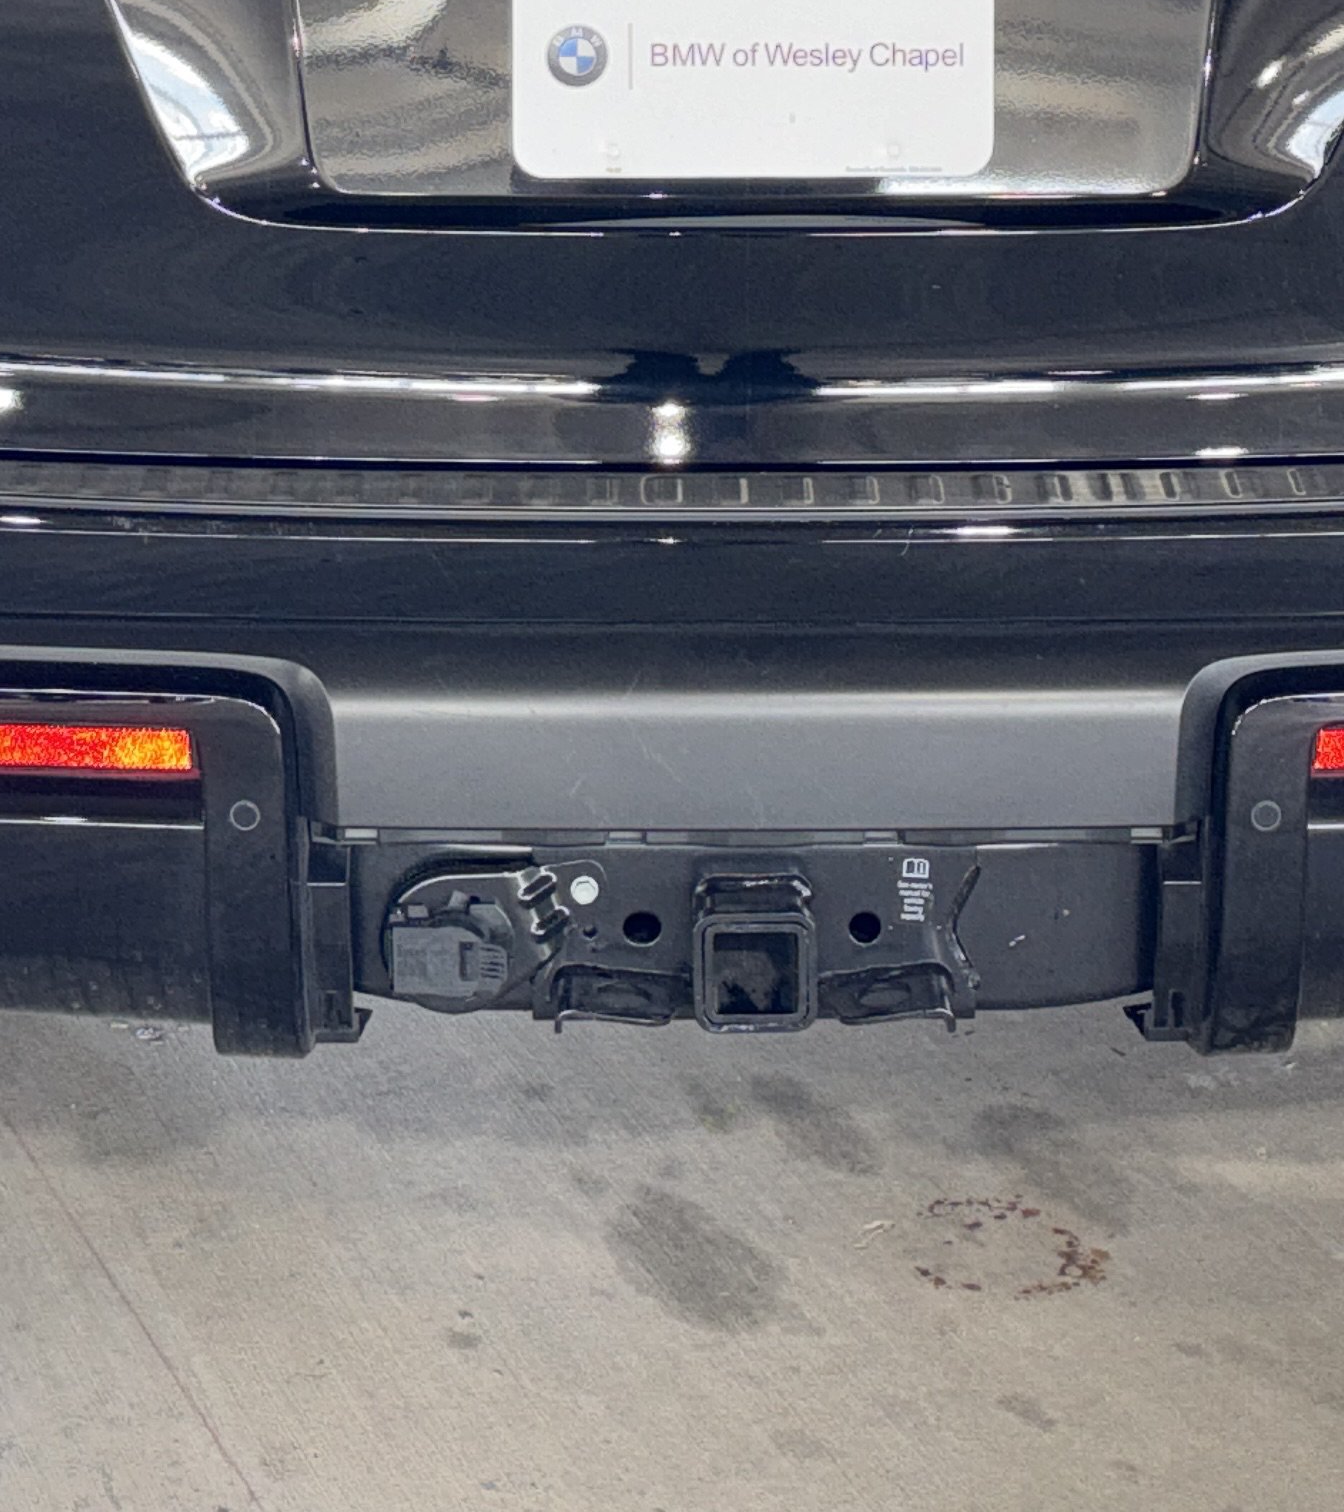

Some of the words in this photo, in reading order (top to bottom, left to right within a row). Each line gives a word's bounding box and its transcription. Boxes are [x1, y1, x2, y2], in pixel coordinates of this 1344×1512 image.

[650, 42, 725, 67] BMW
[732, 42, 759, 67] of
[764, 42, 863, 73] Wesley
[869, 42, 964, 73] Chapel
